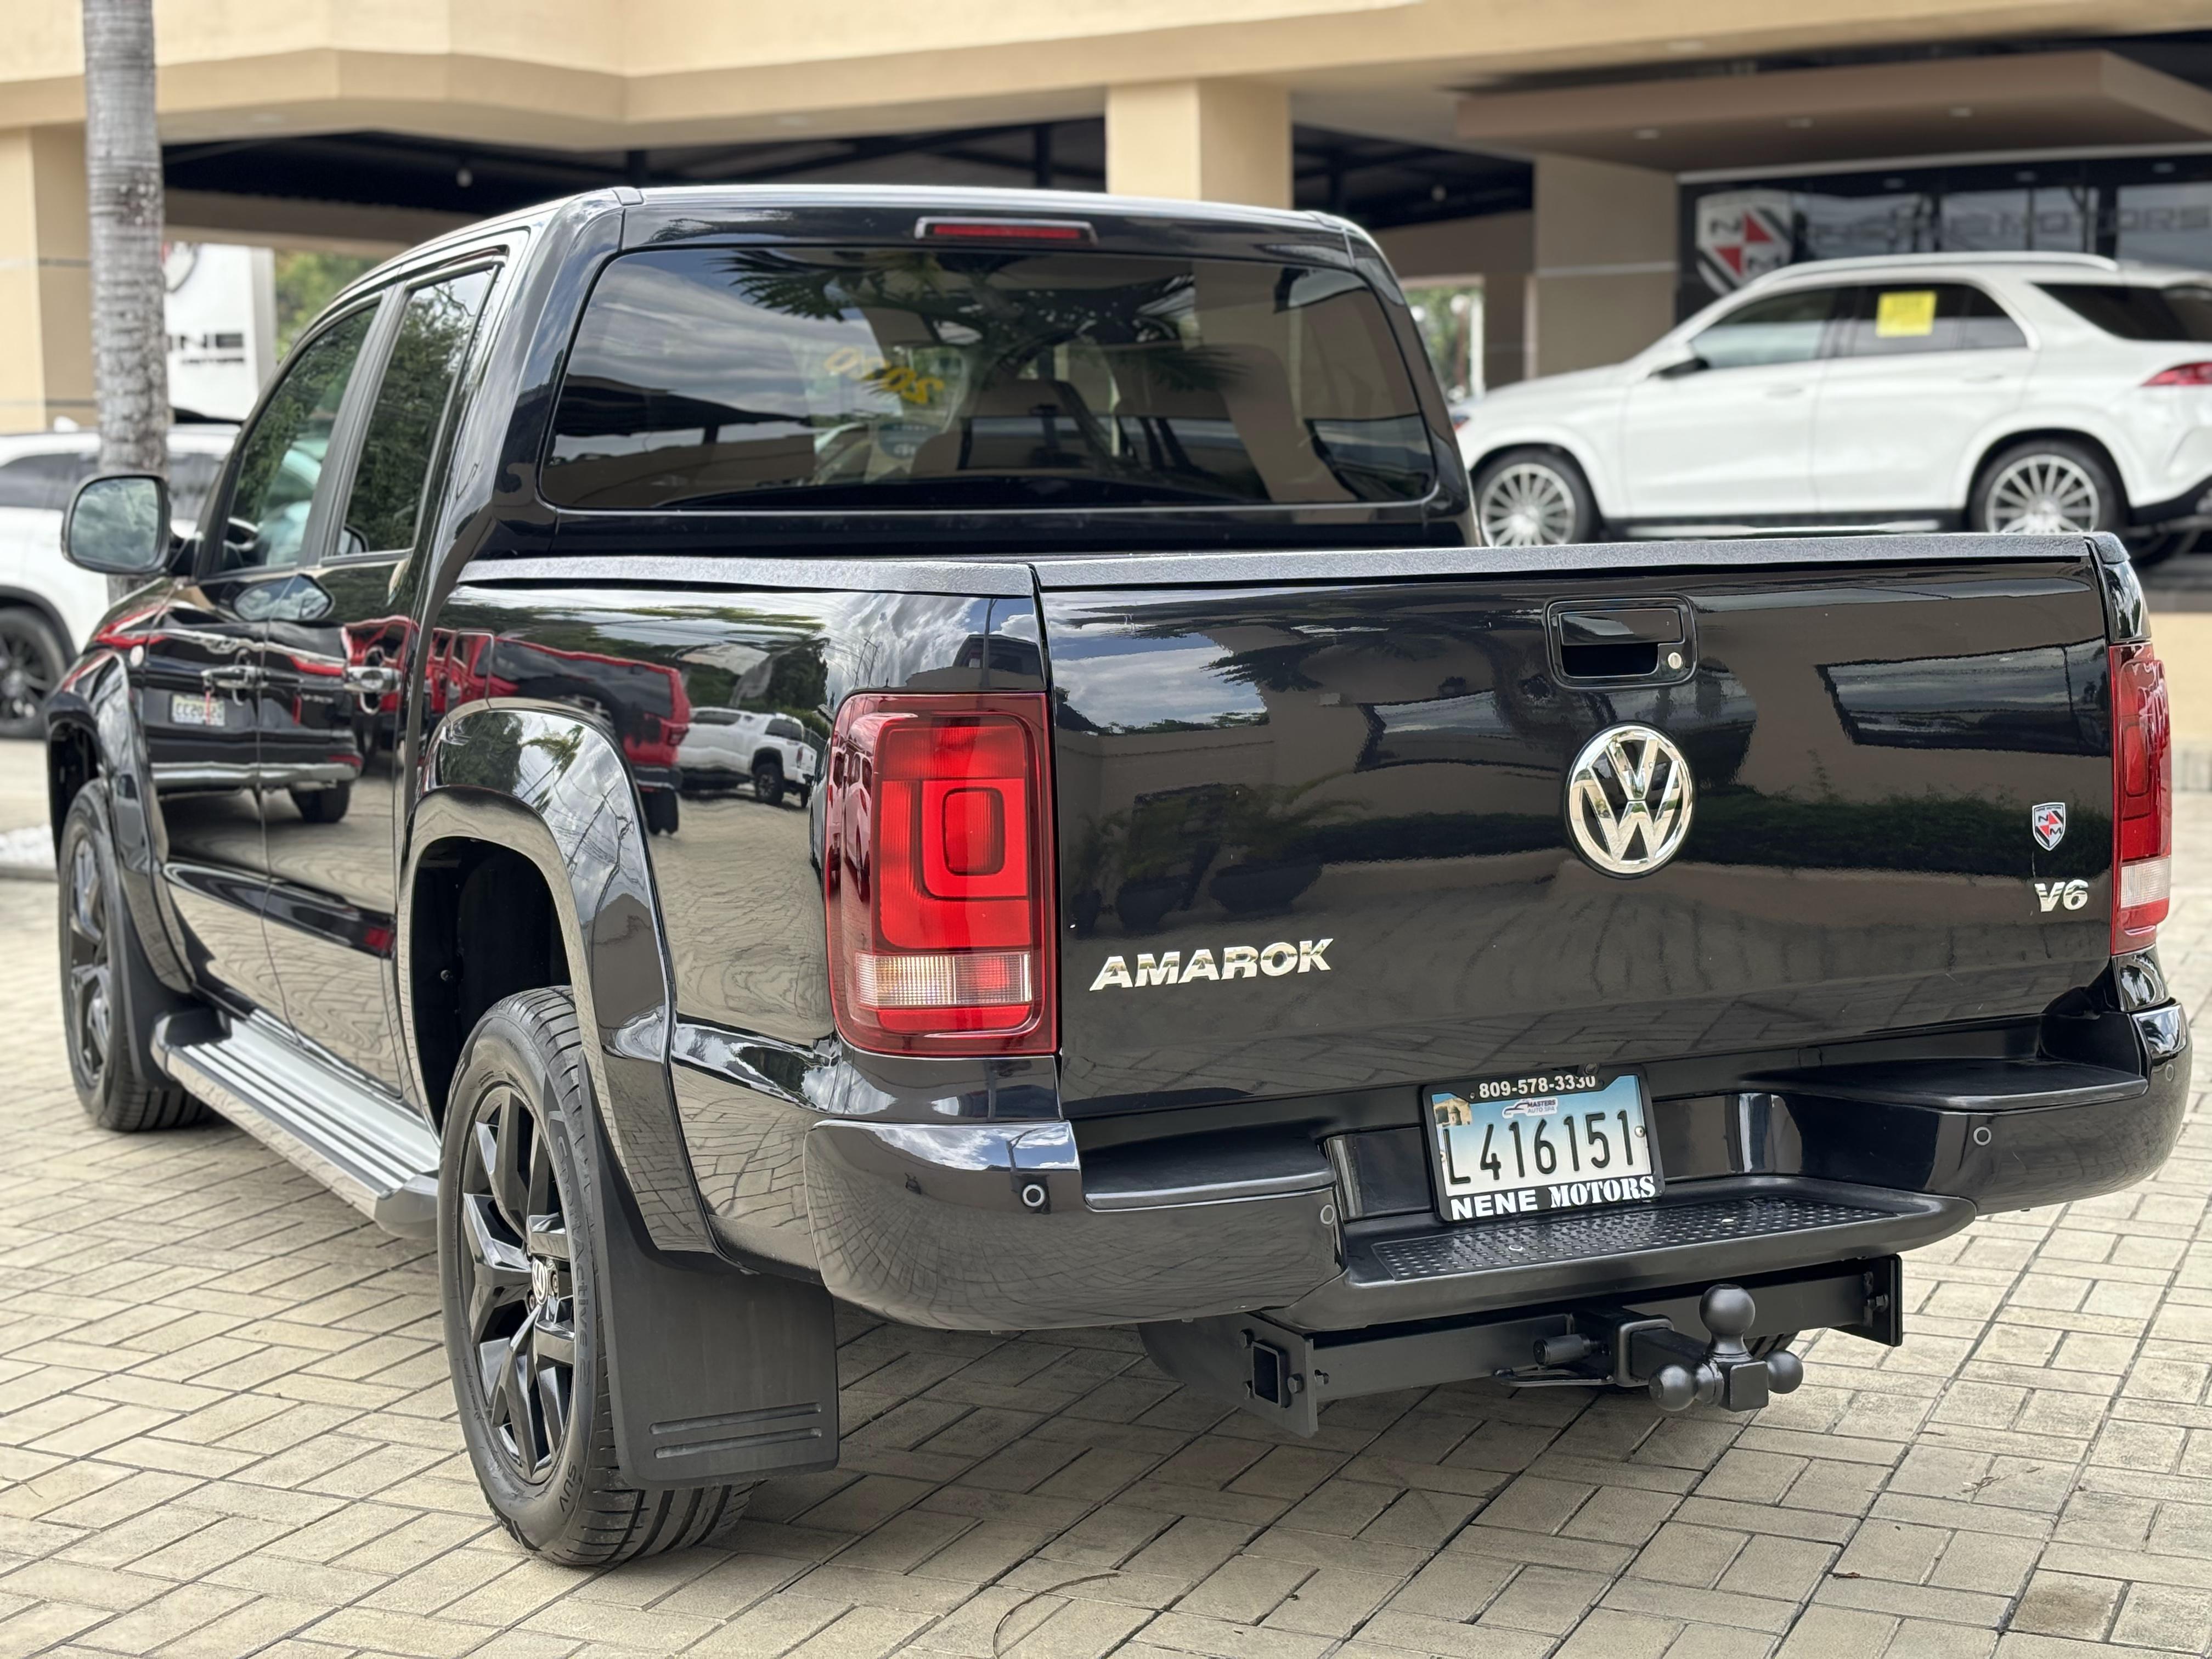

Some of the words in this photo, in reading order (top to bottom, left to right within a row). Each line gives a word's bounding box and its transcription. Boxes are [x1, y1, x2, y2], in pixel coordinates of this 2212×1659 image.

[2034, 879, 2089, 912] V6
[1090, 938, 1334, 991] AMAROK
[1479, 1075, 1596, 1098] 809-578-3330
[1527, 1099, 1556, 1108] MASTERS
[1443, 1110, 1633, 1184] L416151
[1451, 1189, 1538, 1221] NENE
[1548, 1176, 1656, 1208] MOTORS
[558, 1461, 578, 1513] SUV
